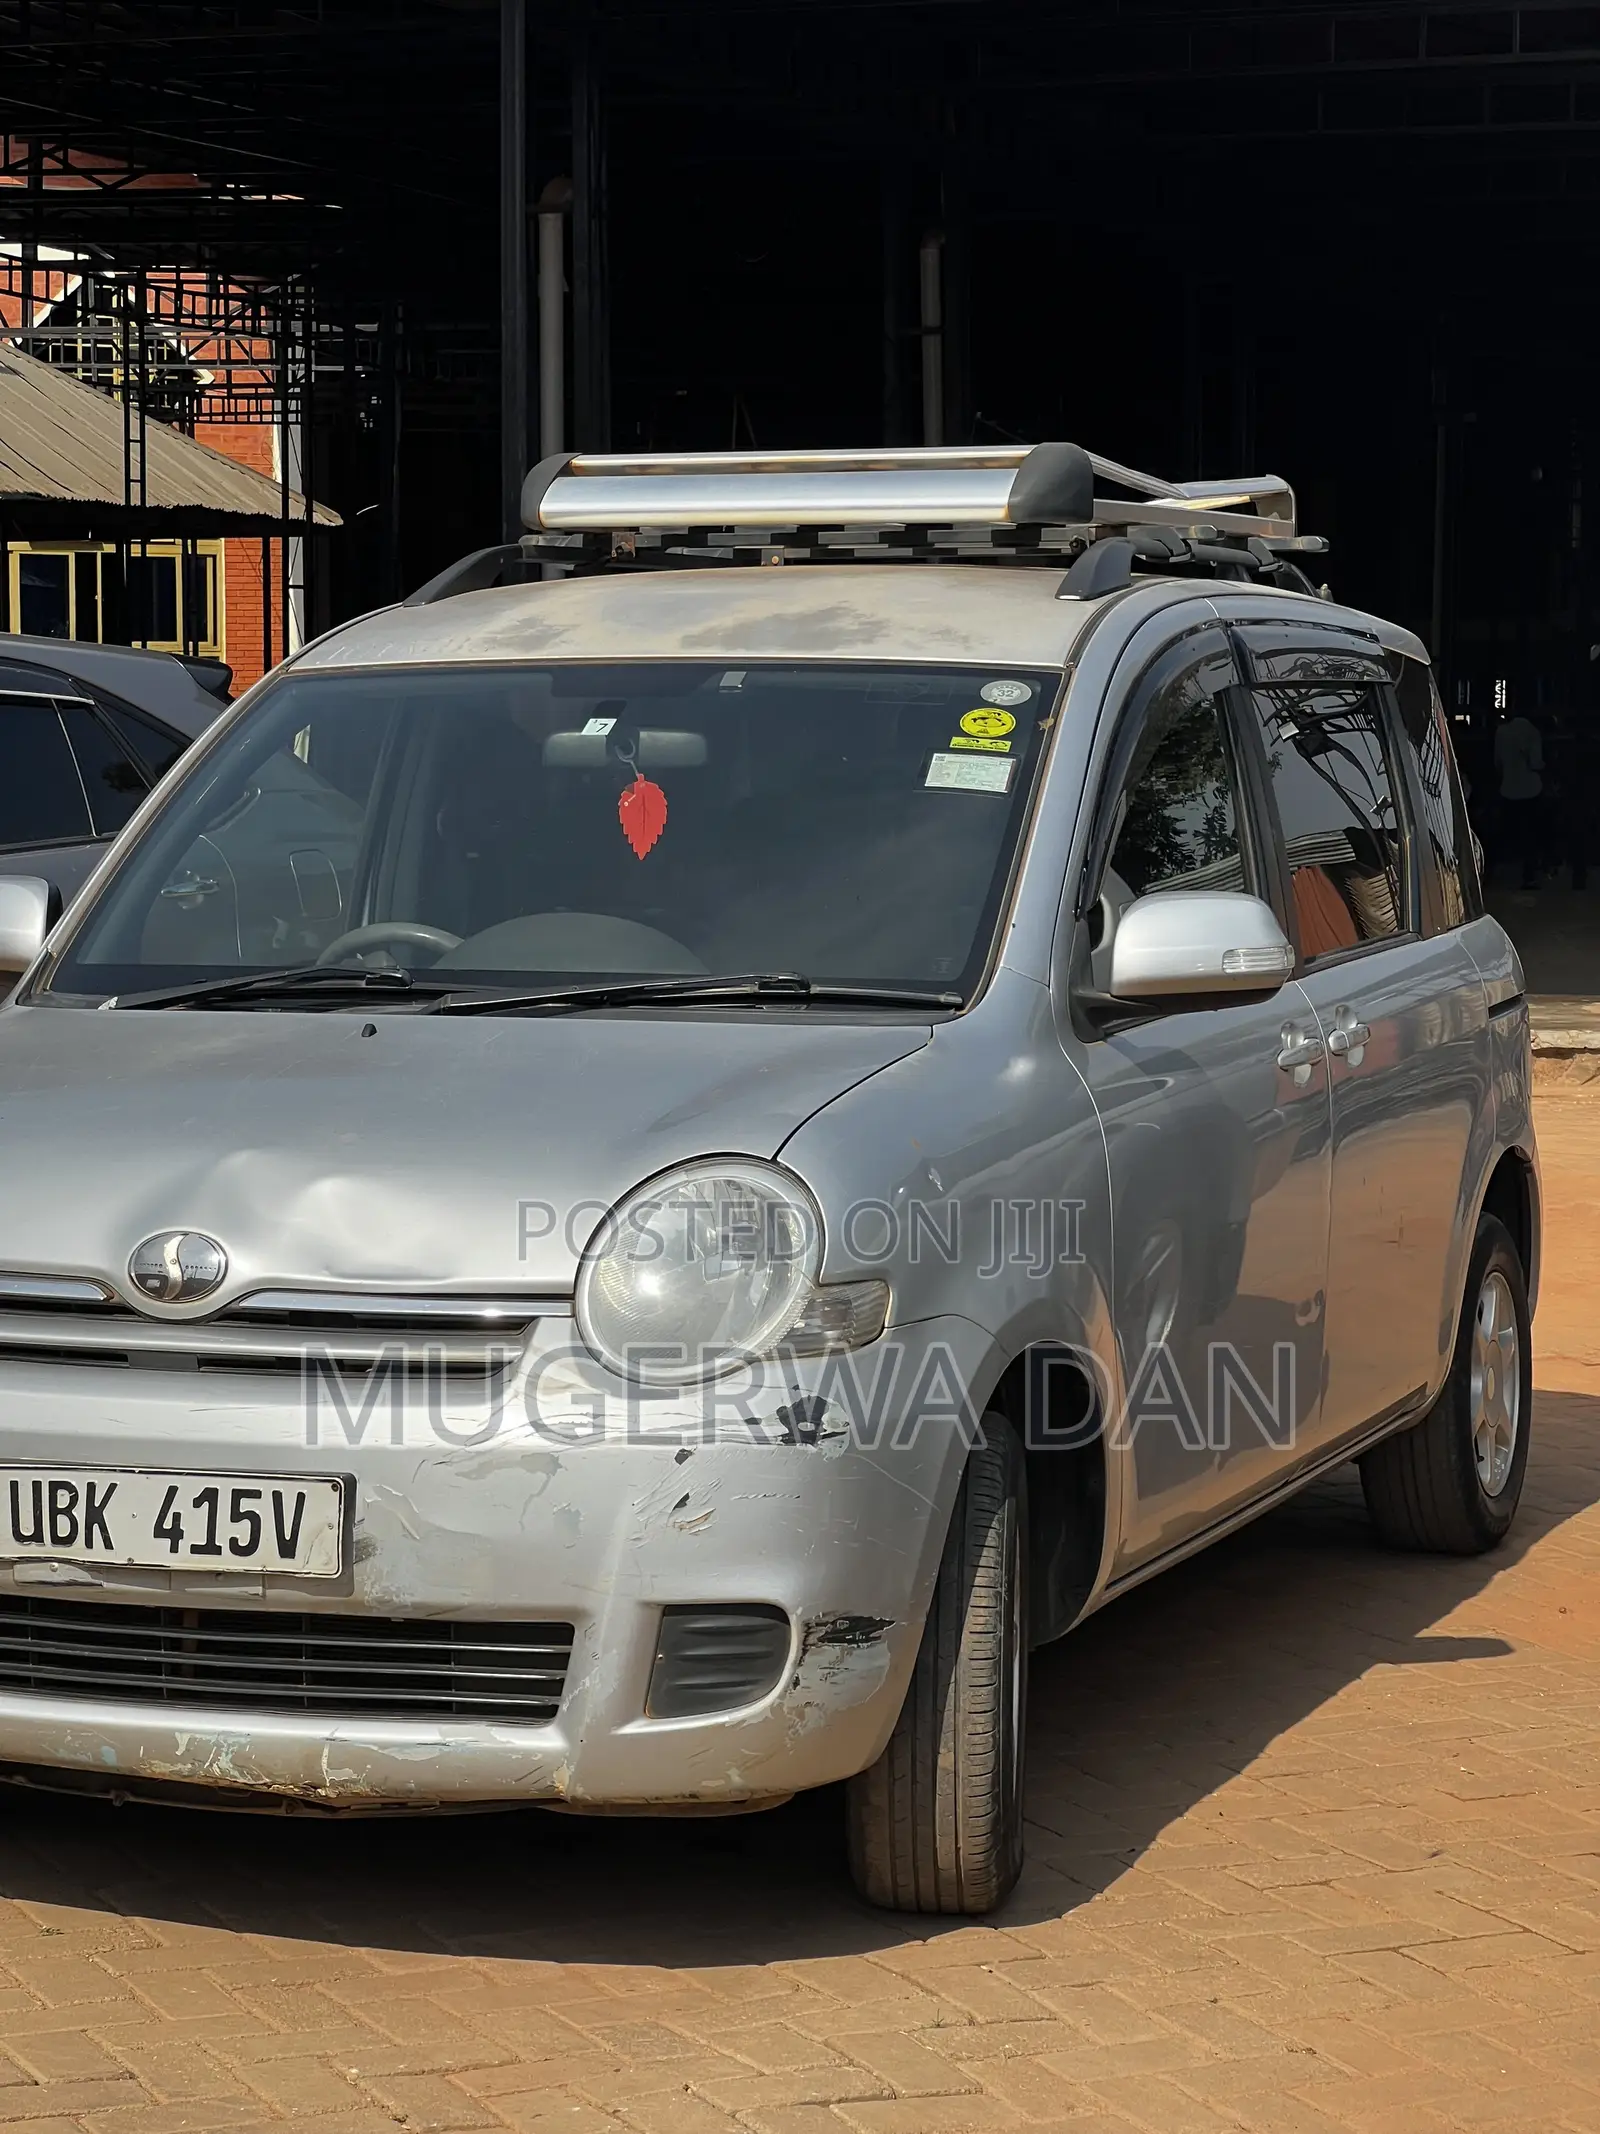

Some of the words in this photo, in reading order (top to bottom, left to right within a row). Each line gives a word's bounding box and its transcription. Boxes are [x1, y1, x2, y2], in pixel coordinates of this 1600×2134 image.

[997, 689, 1014, 698] 32
[596, 723, 609, 733] 7
[9, 1479, 119, 1551] UBK
[153, 1484, 307, 1560] 415V
